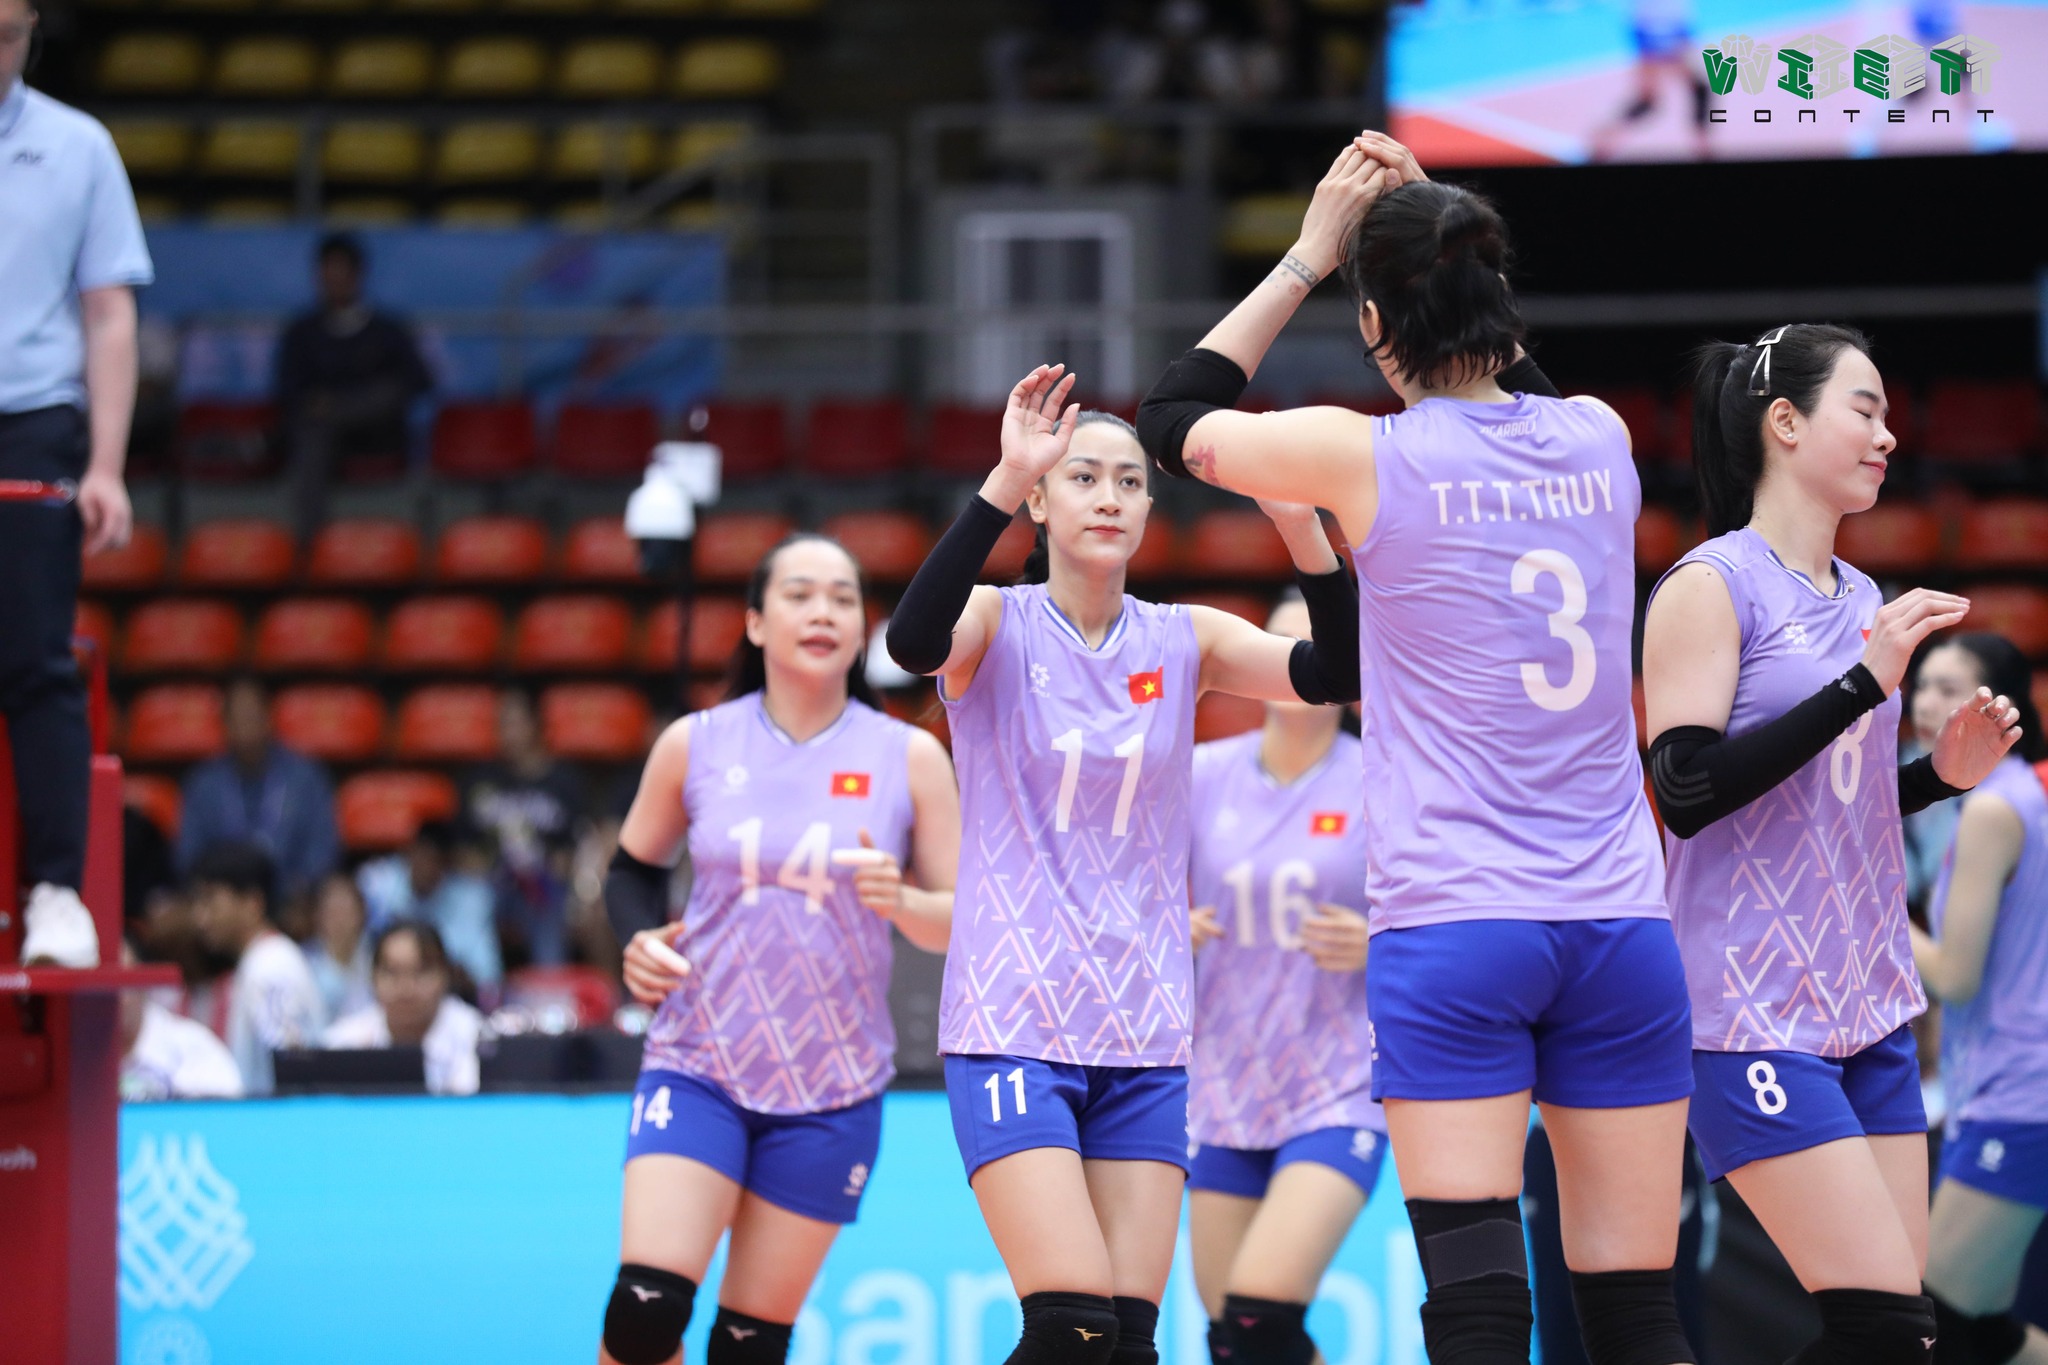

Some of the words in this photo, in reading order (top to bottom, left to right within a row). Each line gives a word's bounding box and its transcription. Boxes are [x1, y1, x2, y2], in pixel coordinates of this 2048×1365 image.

[1429, 468, 1614, 526] T.T.T.THUY
[1510, 548, 1597, 712] 3
[1050, 727, 1145, 837] 11
[1830, 708, 1874, 806] 8
[726, 815, 836, 916] 14
[1222, 859, 1317, 950] 16
[629, 1085, 674, 1137] 14
[984, 1067, 1028, 1123] 11
[1746, 1060, 1788, 1116] 8
